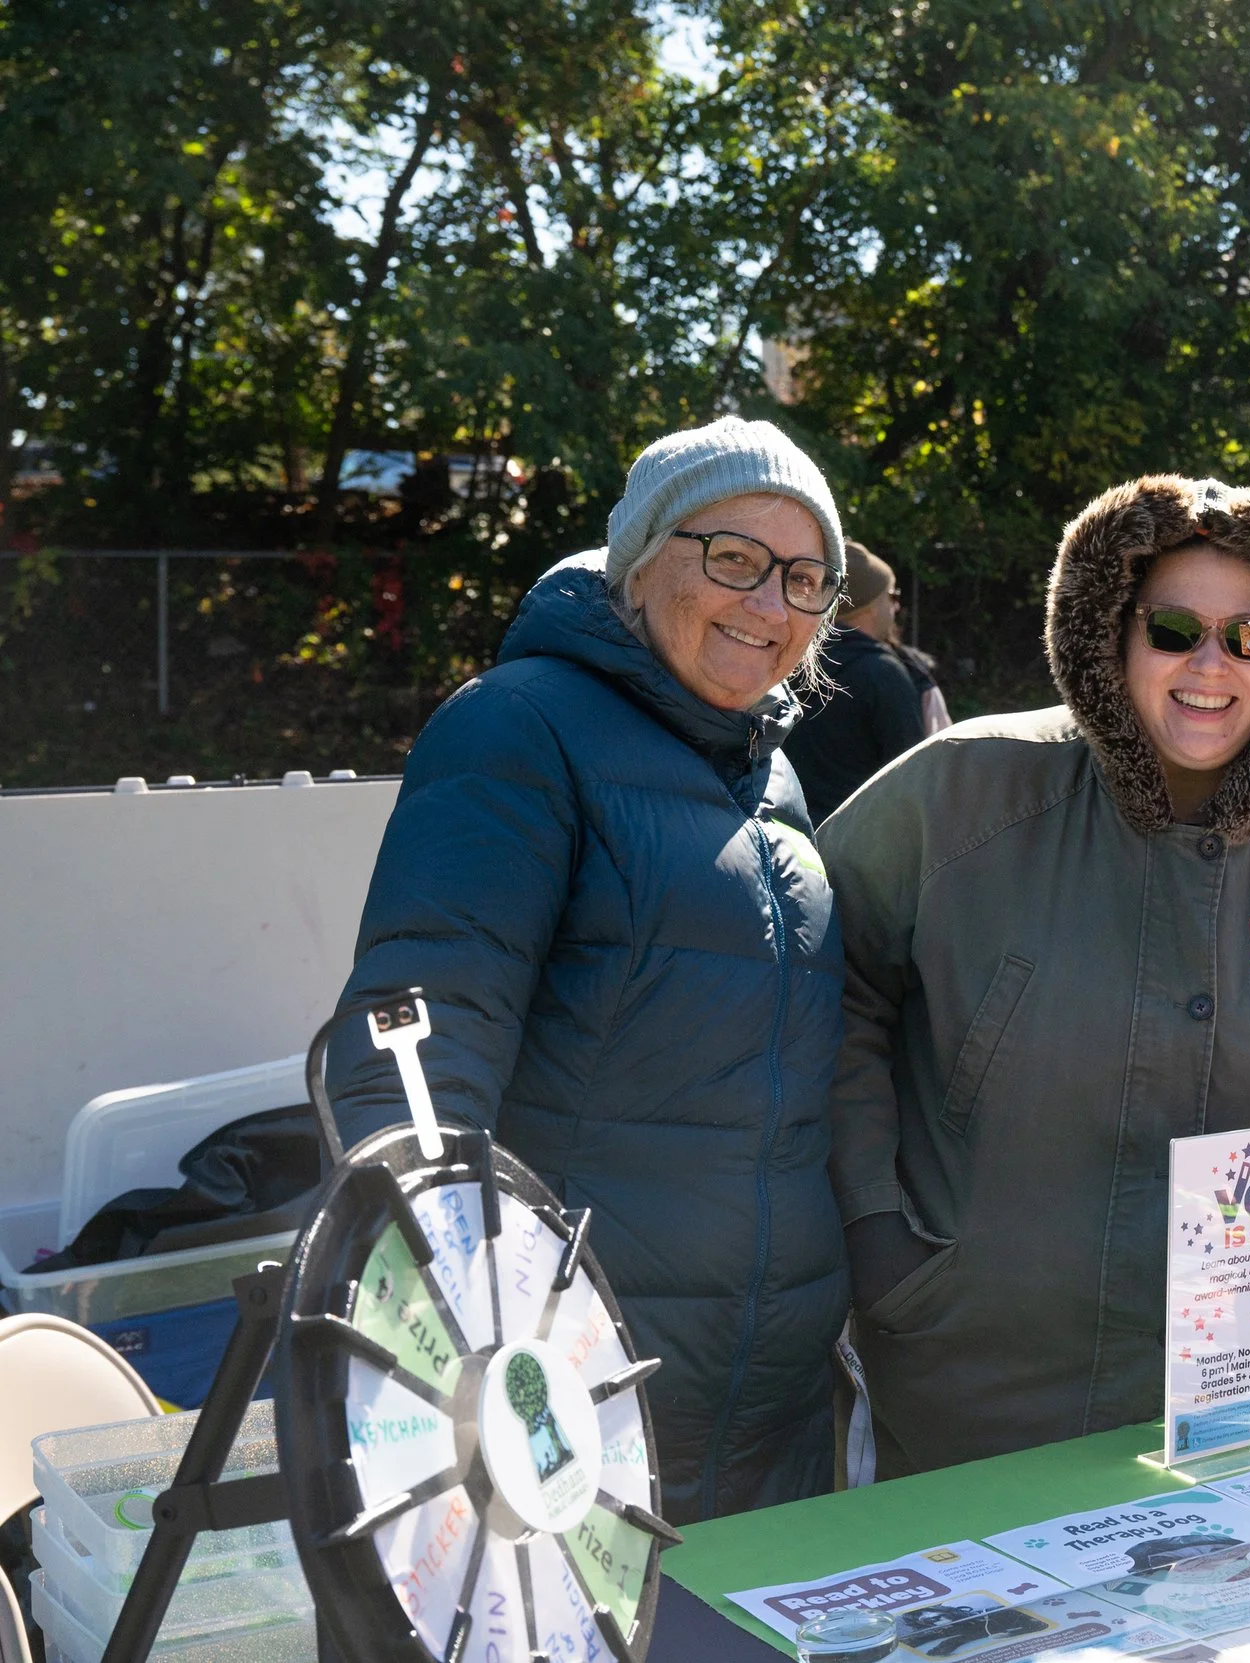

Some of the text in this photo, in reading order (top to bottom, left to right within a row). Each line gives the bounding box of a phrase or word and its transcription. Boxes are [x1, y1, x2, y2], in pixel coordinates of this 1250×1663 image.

[443, 1190, 476, 1257] PEN
[1224, 1225, 1246, 1249] IS
[418, 1211, 464, 1316] PENCIL
[515, 1229, 537, 1297] PIN
[1201, 1259, 1226, 1271] Learn
[1209, 1269, 1248, 1285] magical,
[1196, 1352, 1237, 1367] Monday,
[1201, 1368, 1208, 1378] 6
[1209, 1366, 1225, 1379] pm
[1194, 1384, 1250, 1404] Registration
[1201, 1377, 1234, 1390] Grades
[1235, 1372, 1247, 1382] 5+
[351, 1415, 438, 1445] KEYCHAIN
[1063, 1510, 1168, 1535] Read to a
[1064, 1514, 1207, 1551] Therapy Dog
[402, 1496, 468, 1616] STICKER
[575, 1520, 614, 1573] rize
[778, 1576, 910, 1610] Read to
